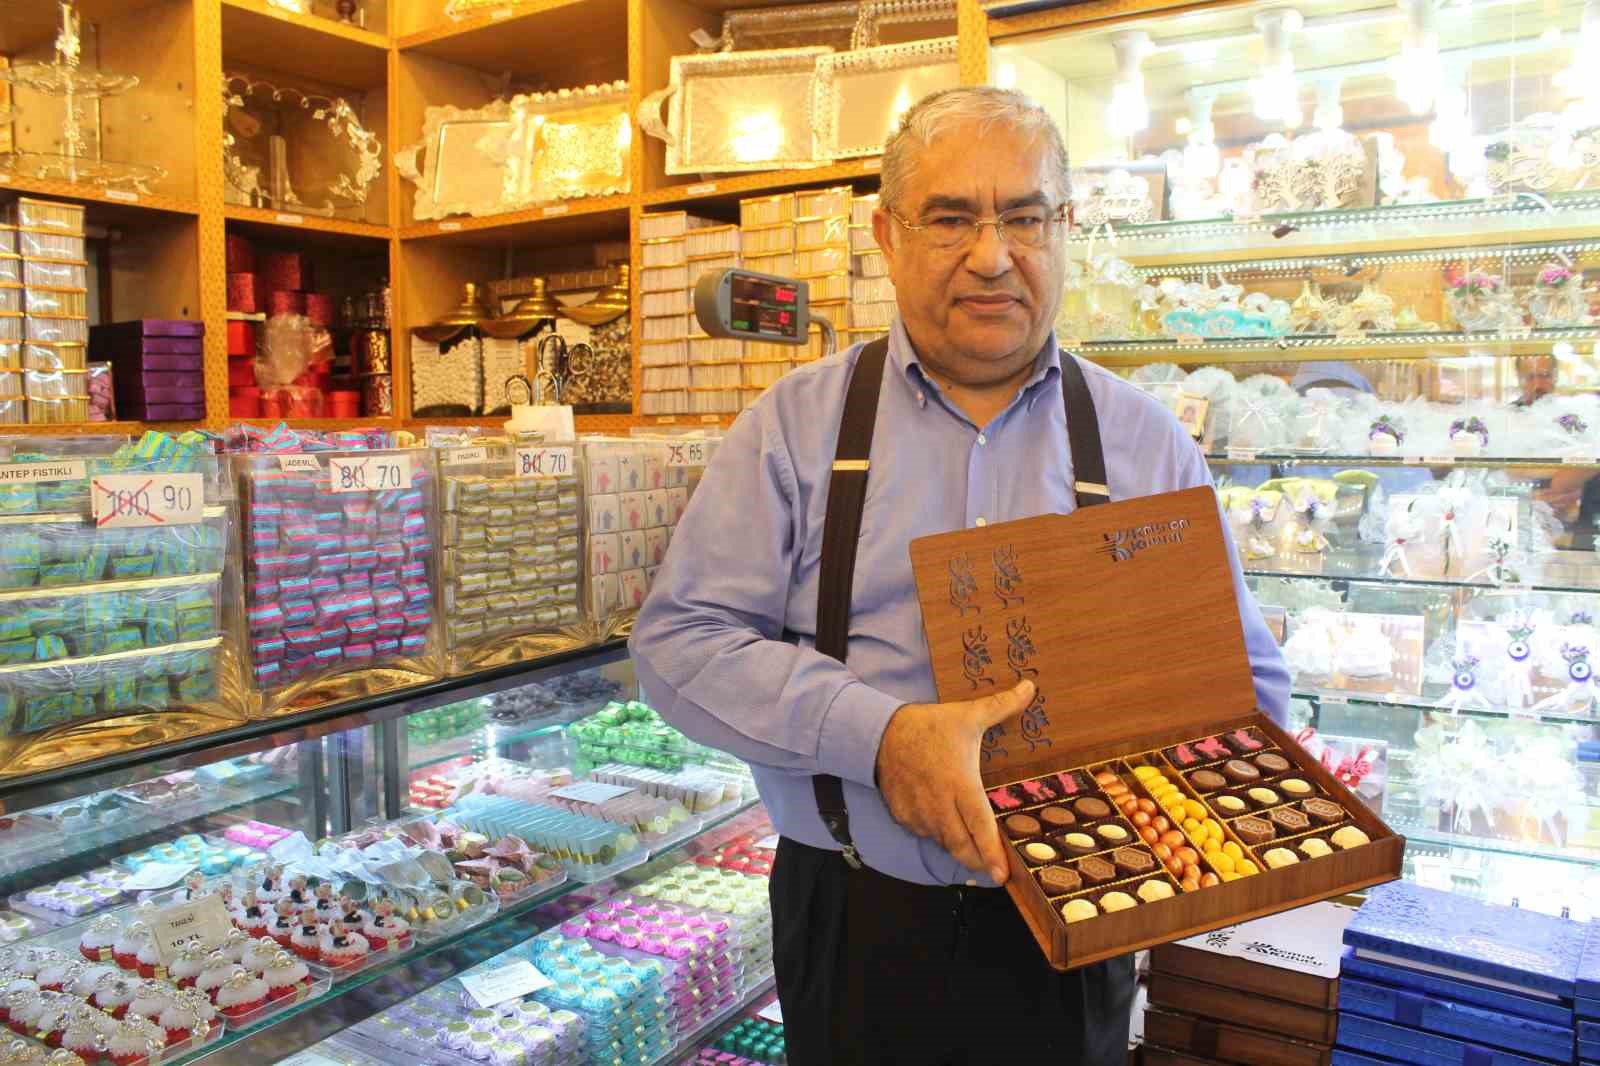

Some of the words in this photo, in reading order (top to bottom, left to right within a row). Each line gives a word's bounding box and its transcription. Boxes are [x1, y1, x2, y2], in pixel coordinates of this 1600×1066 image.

[550, 454, 567, 473] 70
[0, 470, 30, 480] NTEP
[341, 464, 365, 488] 80
[377, 465, 401, 487] 70
[162, 484, 192, 512] 90
